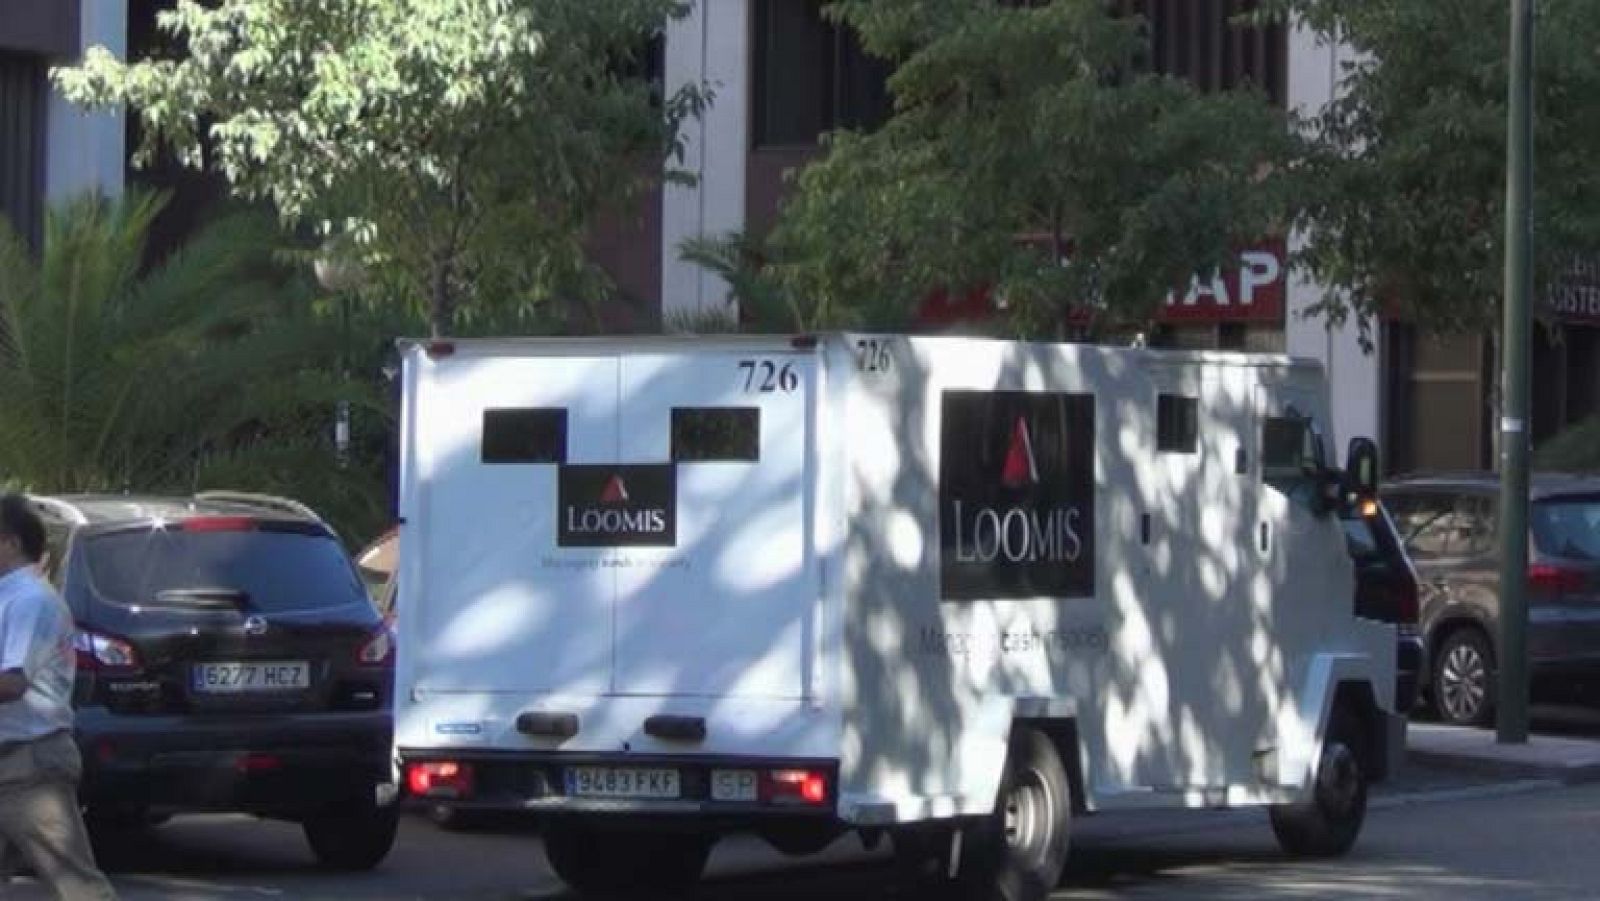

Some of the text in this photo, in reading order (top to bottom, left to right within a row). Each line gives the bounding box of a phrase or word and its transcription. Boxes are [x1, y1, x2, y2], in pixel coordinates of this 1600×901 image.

[858, 339, 892, 372] 726
[737, 360, 799, 393] 726
[567, 505, 666, 533] LOOMIS
[953, 499, 1082, 563] LOOMIS
[206, 665, 256, 686] 6277
[716, 776, 753, 798] SP
